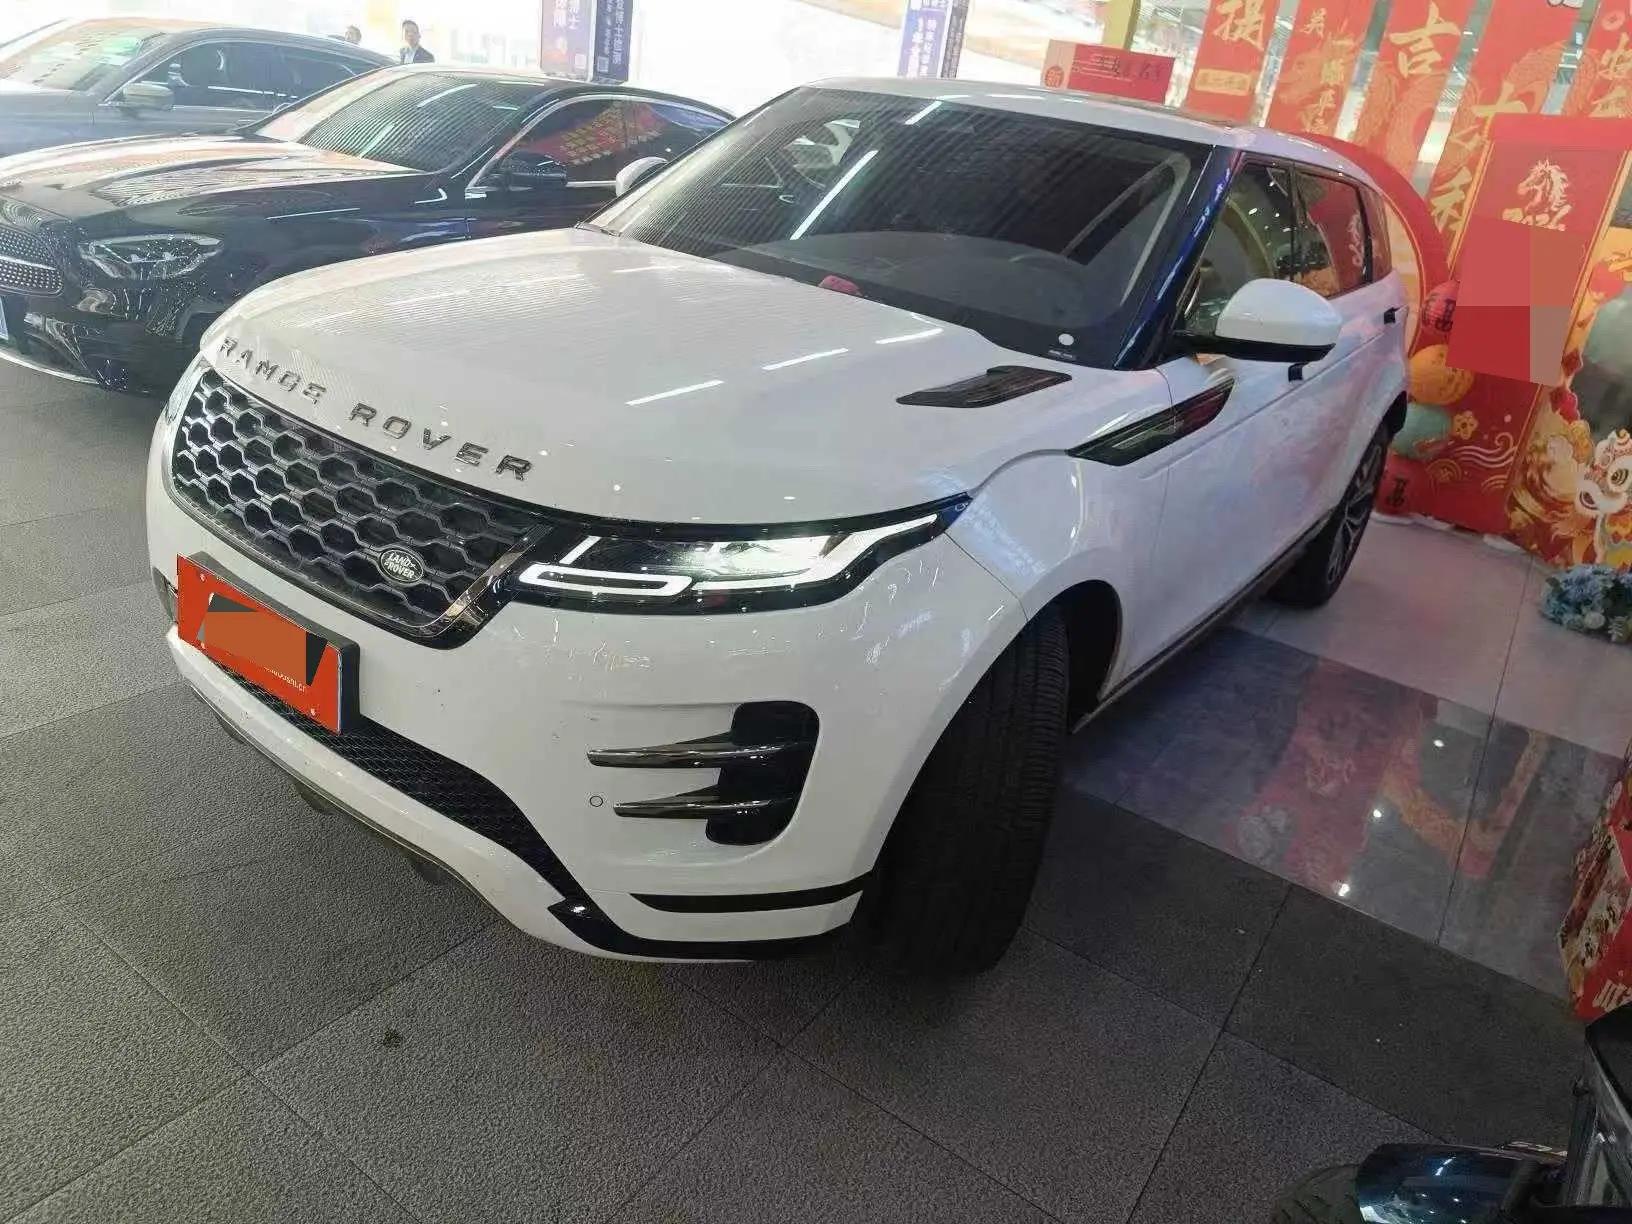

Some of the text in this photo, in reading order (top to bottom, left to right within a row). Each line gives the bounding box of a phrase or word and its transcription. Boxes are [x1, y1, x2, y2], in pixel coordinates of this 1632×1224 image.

[349, 402, 533, 482] ROVER
[387, 552, 411, 568] LAND
[387, 561, 415, 579] ROVER
